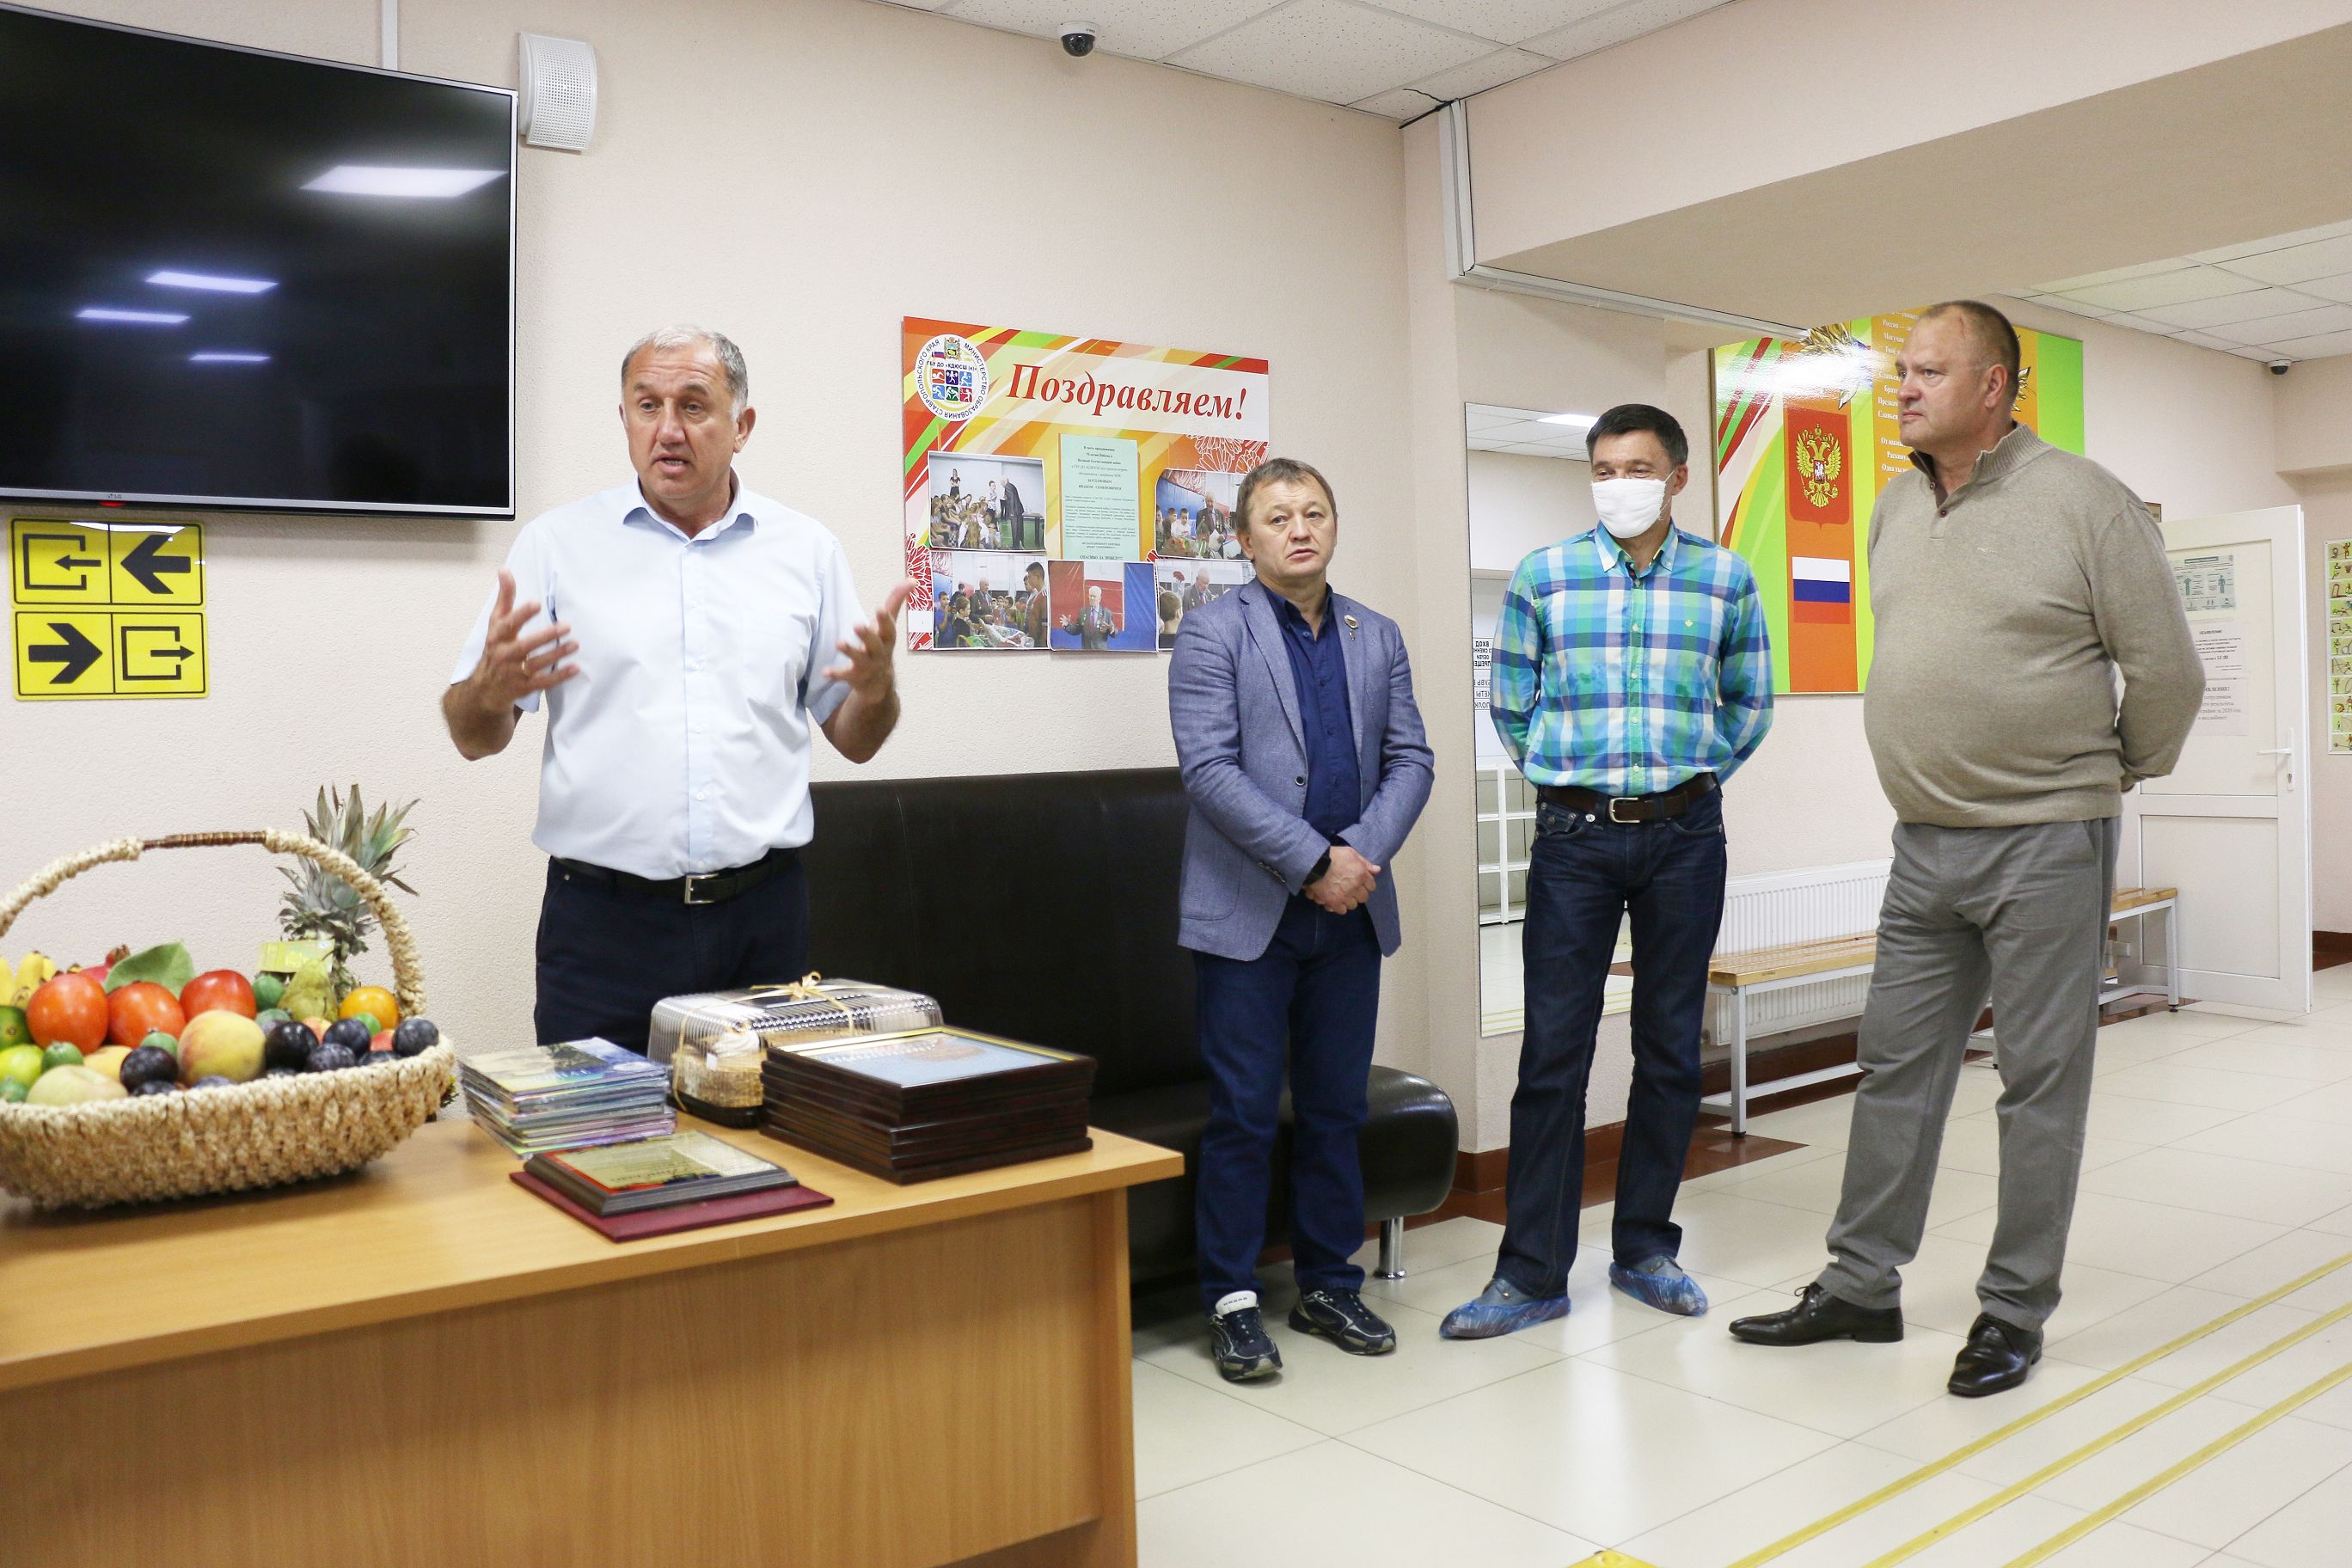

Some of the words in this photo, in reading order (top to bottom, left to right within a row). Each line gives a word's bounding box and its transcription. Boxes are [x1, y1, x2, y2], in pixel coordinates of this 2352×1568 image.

[925, 339, 940, 353] КРАЯ
[964, 342, 987, 395] МИНИСТЕРСТВО
[916, 352, 943, 416] СТАВРОПОЛЬСКОГО
[944, 395, 984, 420] ОБРАЗОВАНИЯ
[1006, 363, 1246, 420] Поздравляем!
